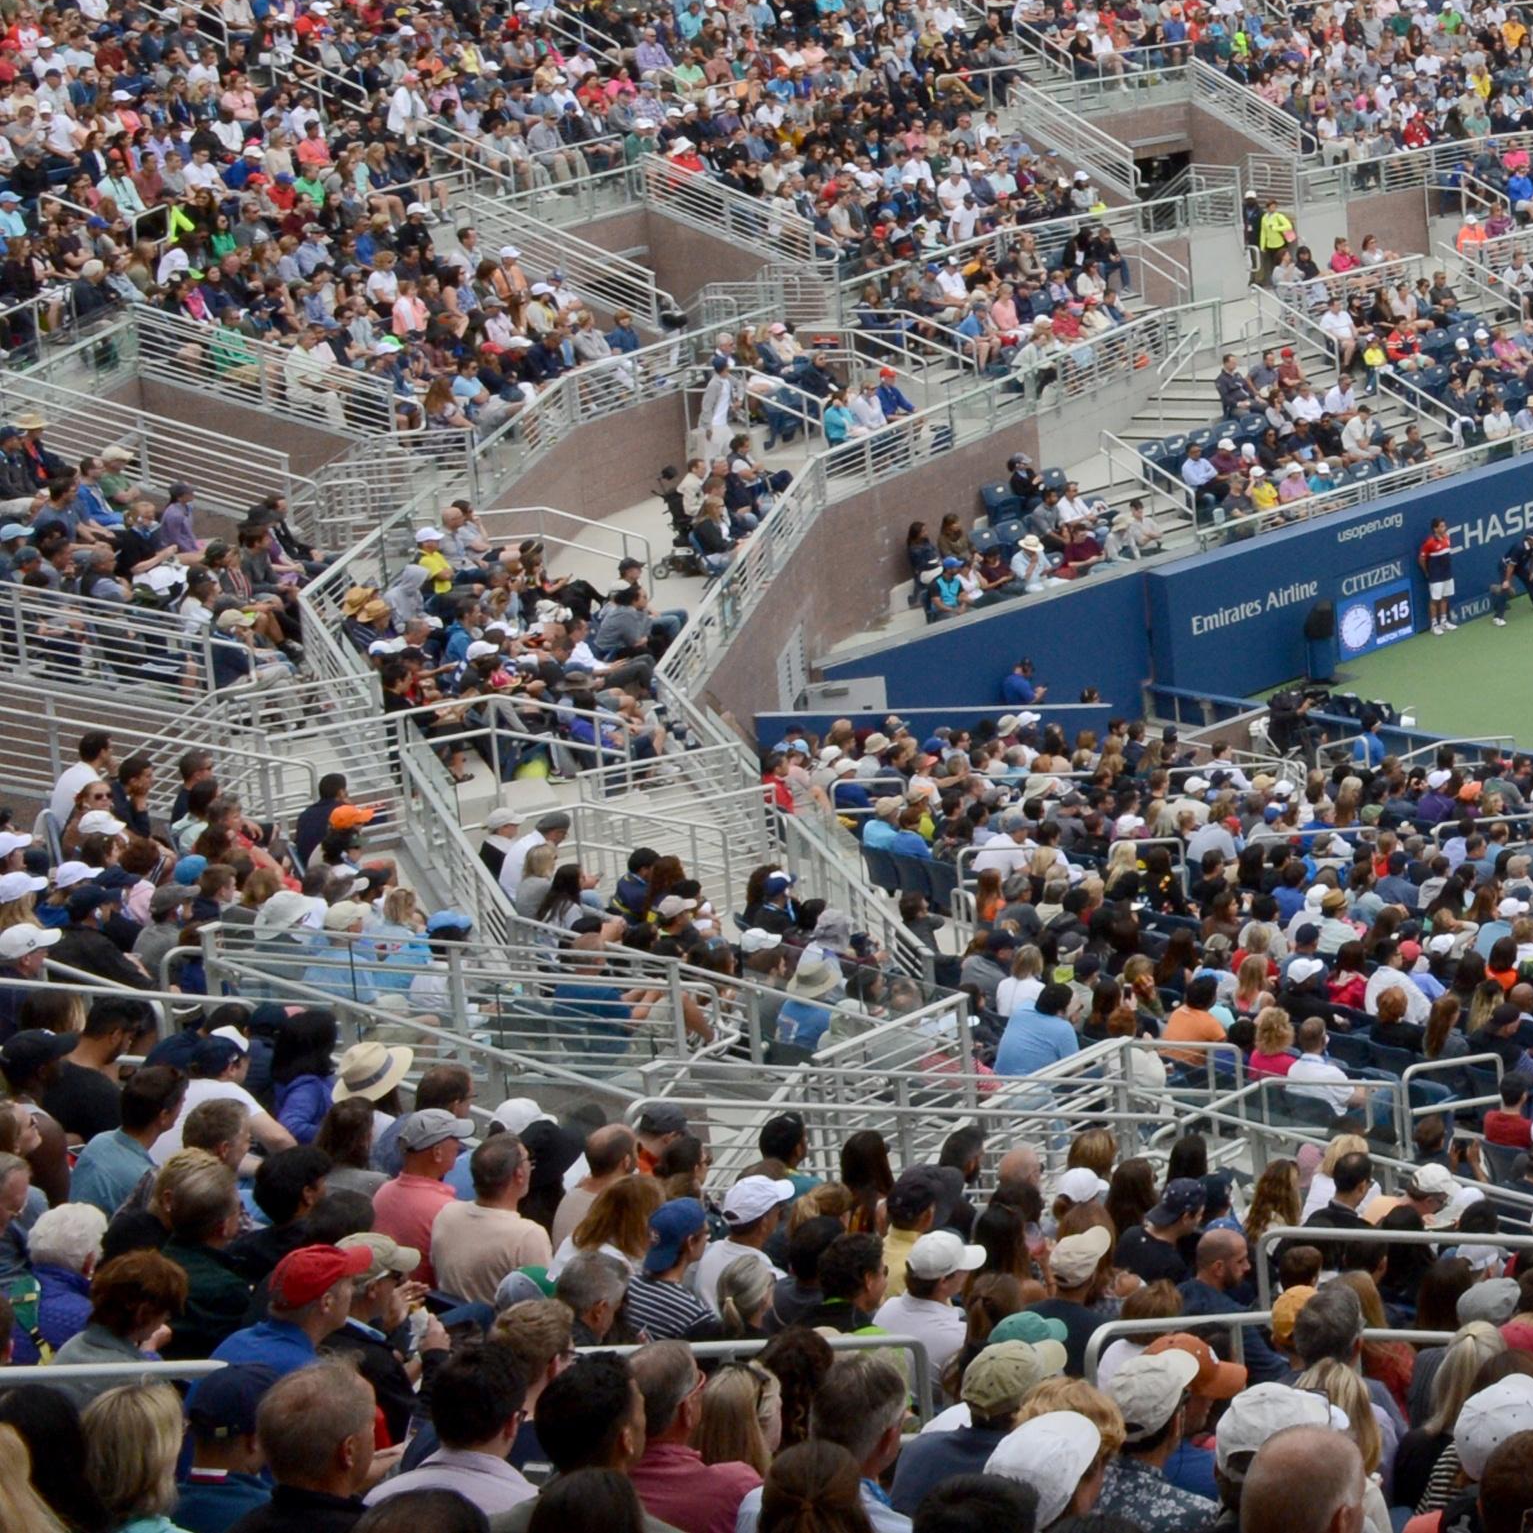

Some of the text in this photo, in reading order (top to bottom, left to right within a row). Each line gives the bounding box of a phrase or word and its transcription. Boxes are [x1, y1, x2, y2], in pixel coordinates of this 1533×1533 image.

[1337, 513, 1403, 542] usopen.org
[1341, 561, 1403, 596] CITIZEN
[1191, 580, 1318, 636] Emirates Airline
[1376, 600, 1410, 626] 1:15
[1461, 597, 1490, 619] POLO
